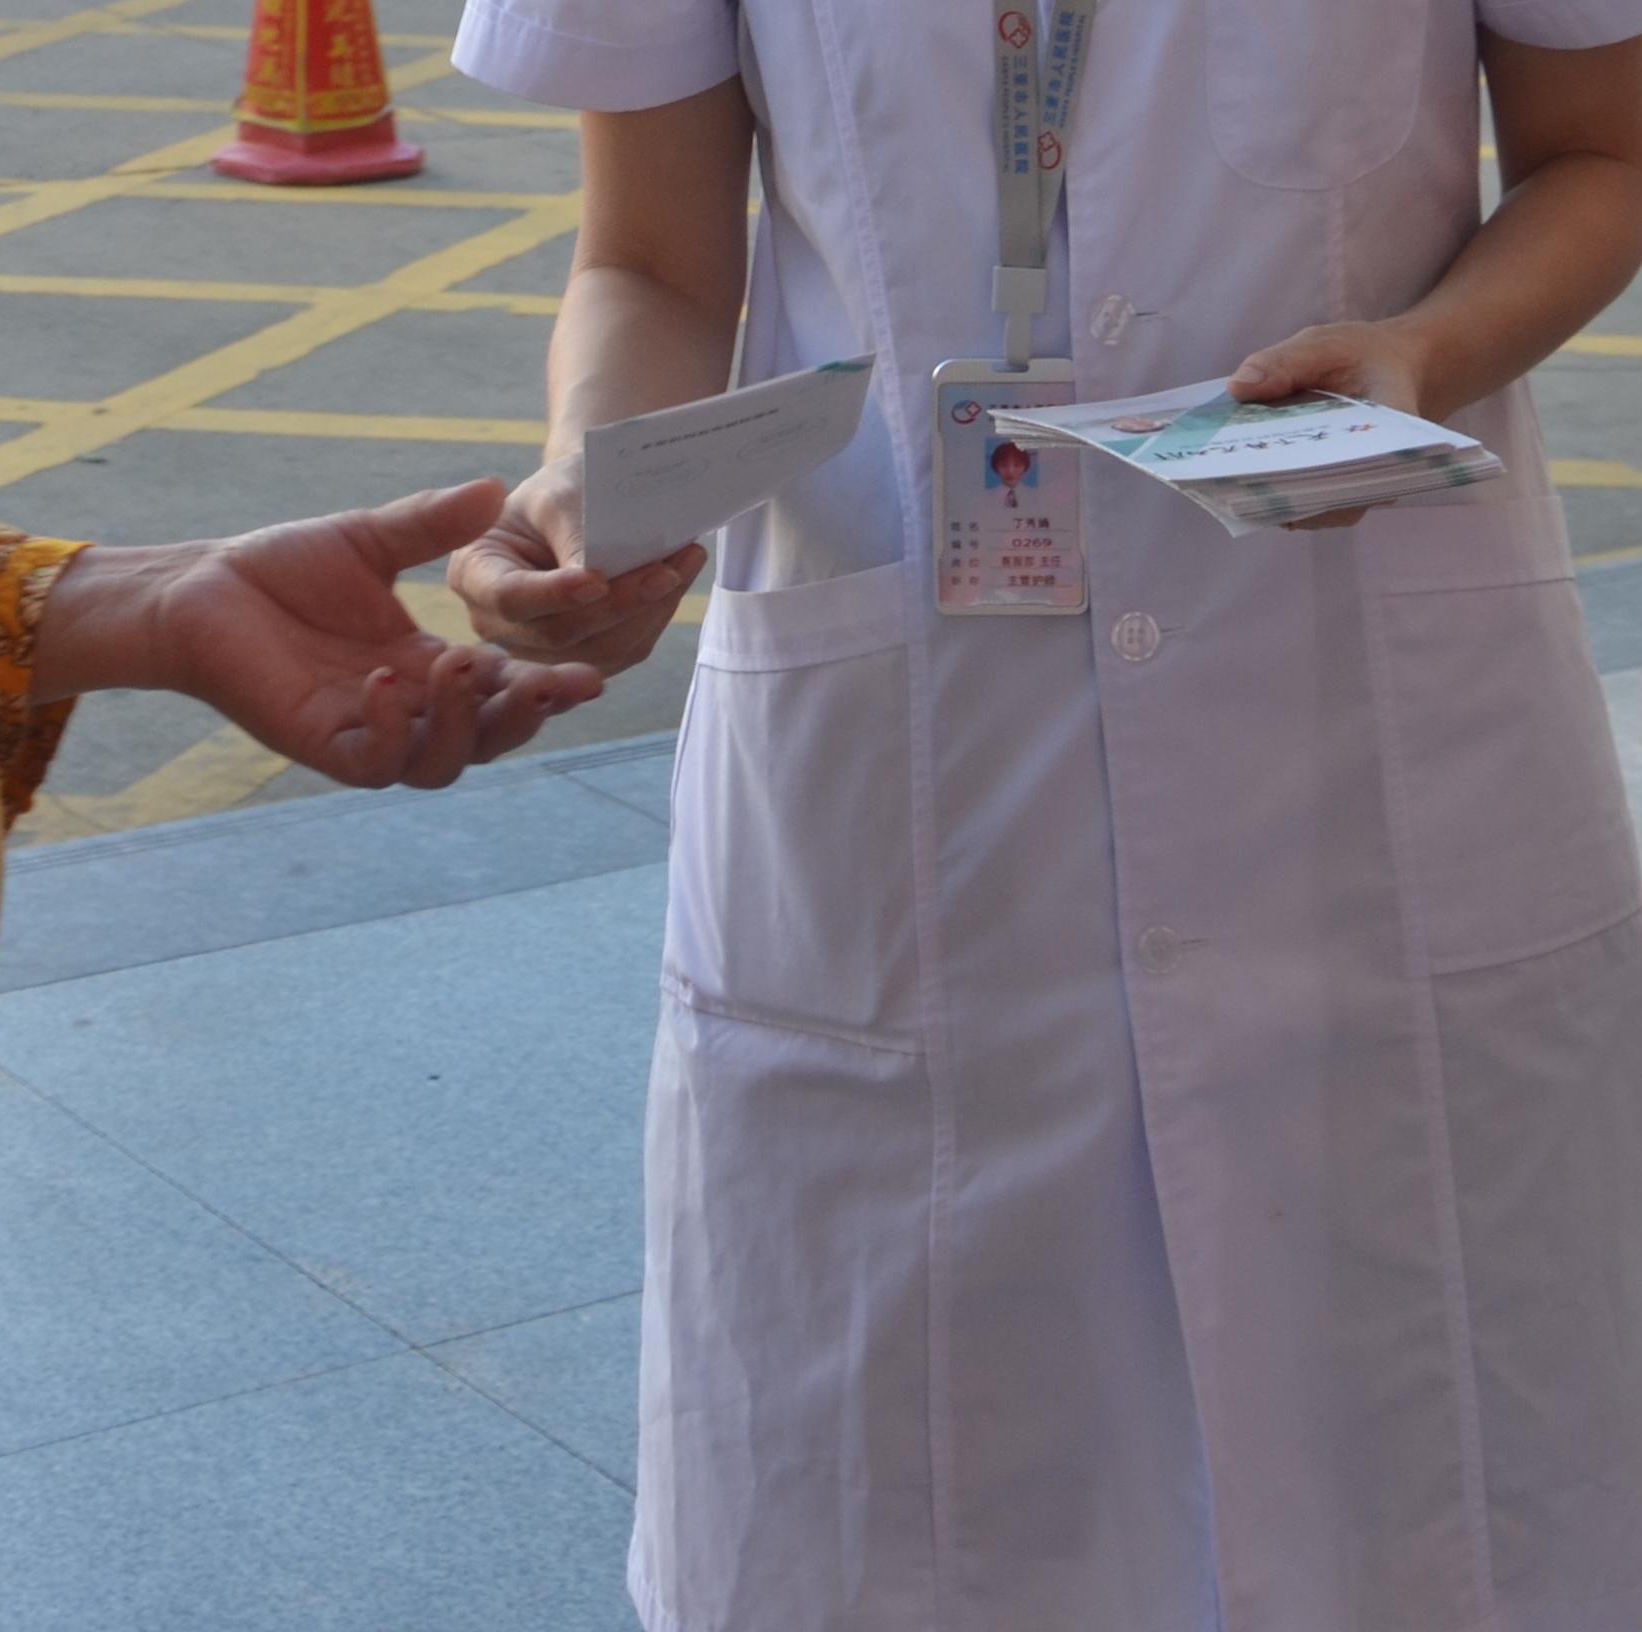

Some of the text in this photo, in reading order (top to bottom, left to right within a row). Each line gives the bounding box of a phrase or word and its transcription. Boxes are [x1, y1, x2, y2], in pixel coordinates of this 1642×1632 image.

[1013, 55, 1030, 175] 三亚市人民医院
[1011, 537, 1053, 548] 0269
